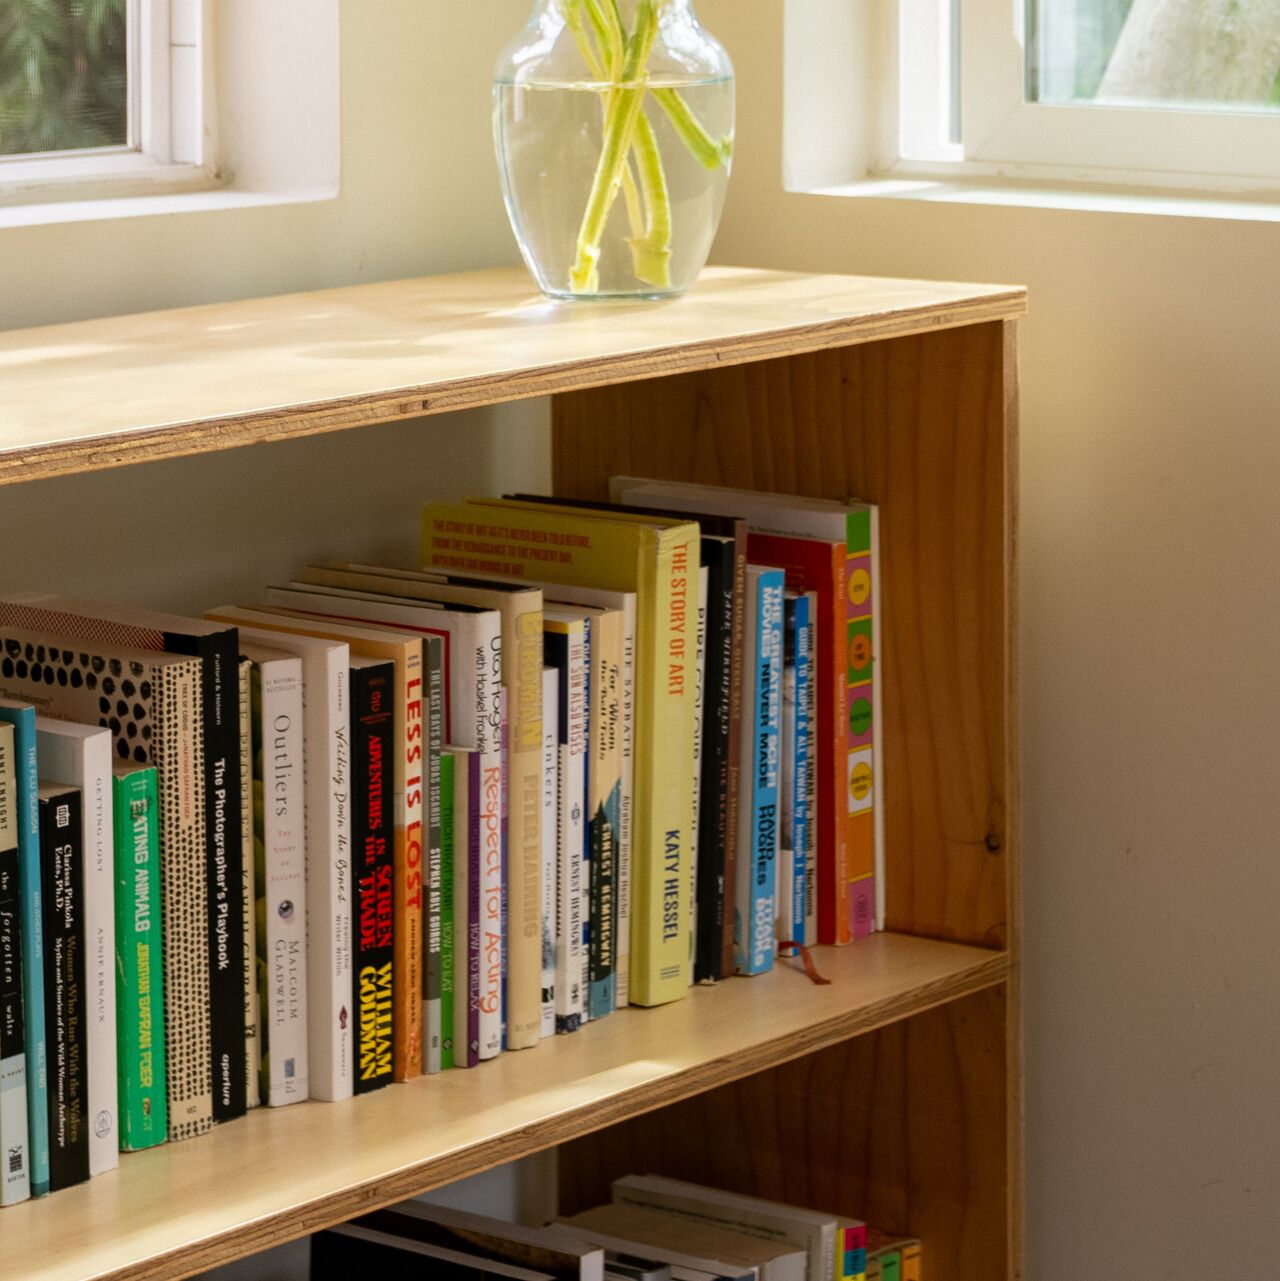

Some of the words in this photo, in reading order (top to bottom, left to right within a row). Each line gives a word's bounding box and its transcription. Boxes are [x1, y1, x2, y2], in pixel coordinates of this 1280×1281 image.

[671, 542, 688, 573] THE
[670, 577, 687, 634] STORY
[762, 586, 772, 658] MOVIES
[771, 585, 783, 624] THE
[475, 646, 487, 671] with
[570, 643, 582, 664] THE
[624, 634, 633, 671] THE
[669, 638, 686, 660] OF
[476, 673, 488, 713] Haskel
[570, 666, 582, 688] SUN
[608, 663, 619, 694] For
[668, 663, 685, 697] ART
[760, 663, 771, 727] NEVER
[769, 628, 782, 732] GREATEST
[407, 677, 421, 764] LESS
[570, 692, 582, 719] ALSO
[608, 697, 620, 753] Whom
[623, 679, 632, 758] SABBATH
[476, 715, 488, 755] Frankel
[570, 722, 582, 756] RISES
[214, 757, 226, 785] The
[272, 713, 294, 817] Outliers
[368, 734, 383, 830] ADVENTURES
[545, 734, 556, 808] tinkers
[759, 733, 770, 789] MADE
[767, 734, 779, 788] SCI-FI
[95, 777, 103, 836] GETTING
[407, 775, 421, 809] IS
[130, 798, 150, 865] EATING
[479, 766, 501, 877] Respect
[622, 795, 630, 839] Abraham
[766, 803, 776, 861] DAVID
[63, 843, 73, 886] Clarissa
[96, 840, 104, 873] LOST
[213, 789, 228, 900] Photographer's
[375, 837, 386, 855] IN
[406, 820, 422, 909] LOST
[600, 822, 612, 877] ERNEST
[621, 843, 629, 877] Joshua
[663, 829, 681, 873] KATY
[757, 806, 767, 886] HUGHES
[1, 871, 9, 891] the
[429, 847, 441, 889] STEPHEN
[570, 854, 580, 893] ERNEST
[64, 888, 74, 928] Pinkola
[134, 868, 151, 933] ANIMALS
[358, 872, 376, 952] TRADE
[375, 863, 393, 948] SCREEN
[430, 891, 441, 914] ADLY
[485, 885, 502, 920] for
[620, 880, 628, 919] Heschel
[663, 879, 680, 943] HESSEL
[0, 911, 14, 983] forgotten
[97, 927, 105, 967] ANNIE
[214, 903, 229, 971] Playbook
[430, 916, 441, 954] GUIRGIS
[570, 897, 581, 957] HEMINGWAY
[599, 883, 611, 967] HEMINGWAY
[66, 935, 76, 981] Women
[288, 939, 300, 1019] MALCOLM
[479, 930, 502, 1015] Acting
[67, 983, 77, 1014] Who
[98, 972, 106, 1023] ERNAUX
[275, 938, 287, 1026] GLADWELL
[5, 1004, 14, 1037] waltz
[68, 1016, 78, 1042] Run
[358, 965, 377, 1081] GOLDMAN
[376, 961, 393, 1076] WILLIAM
[69, 1043, 79, 1076] With
[222, 1053, 231, 1106] aperture
[70, 1077, 80, 1101] the
[70, 1103, 81, 1143] Wolves
